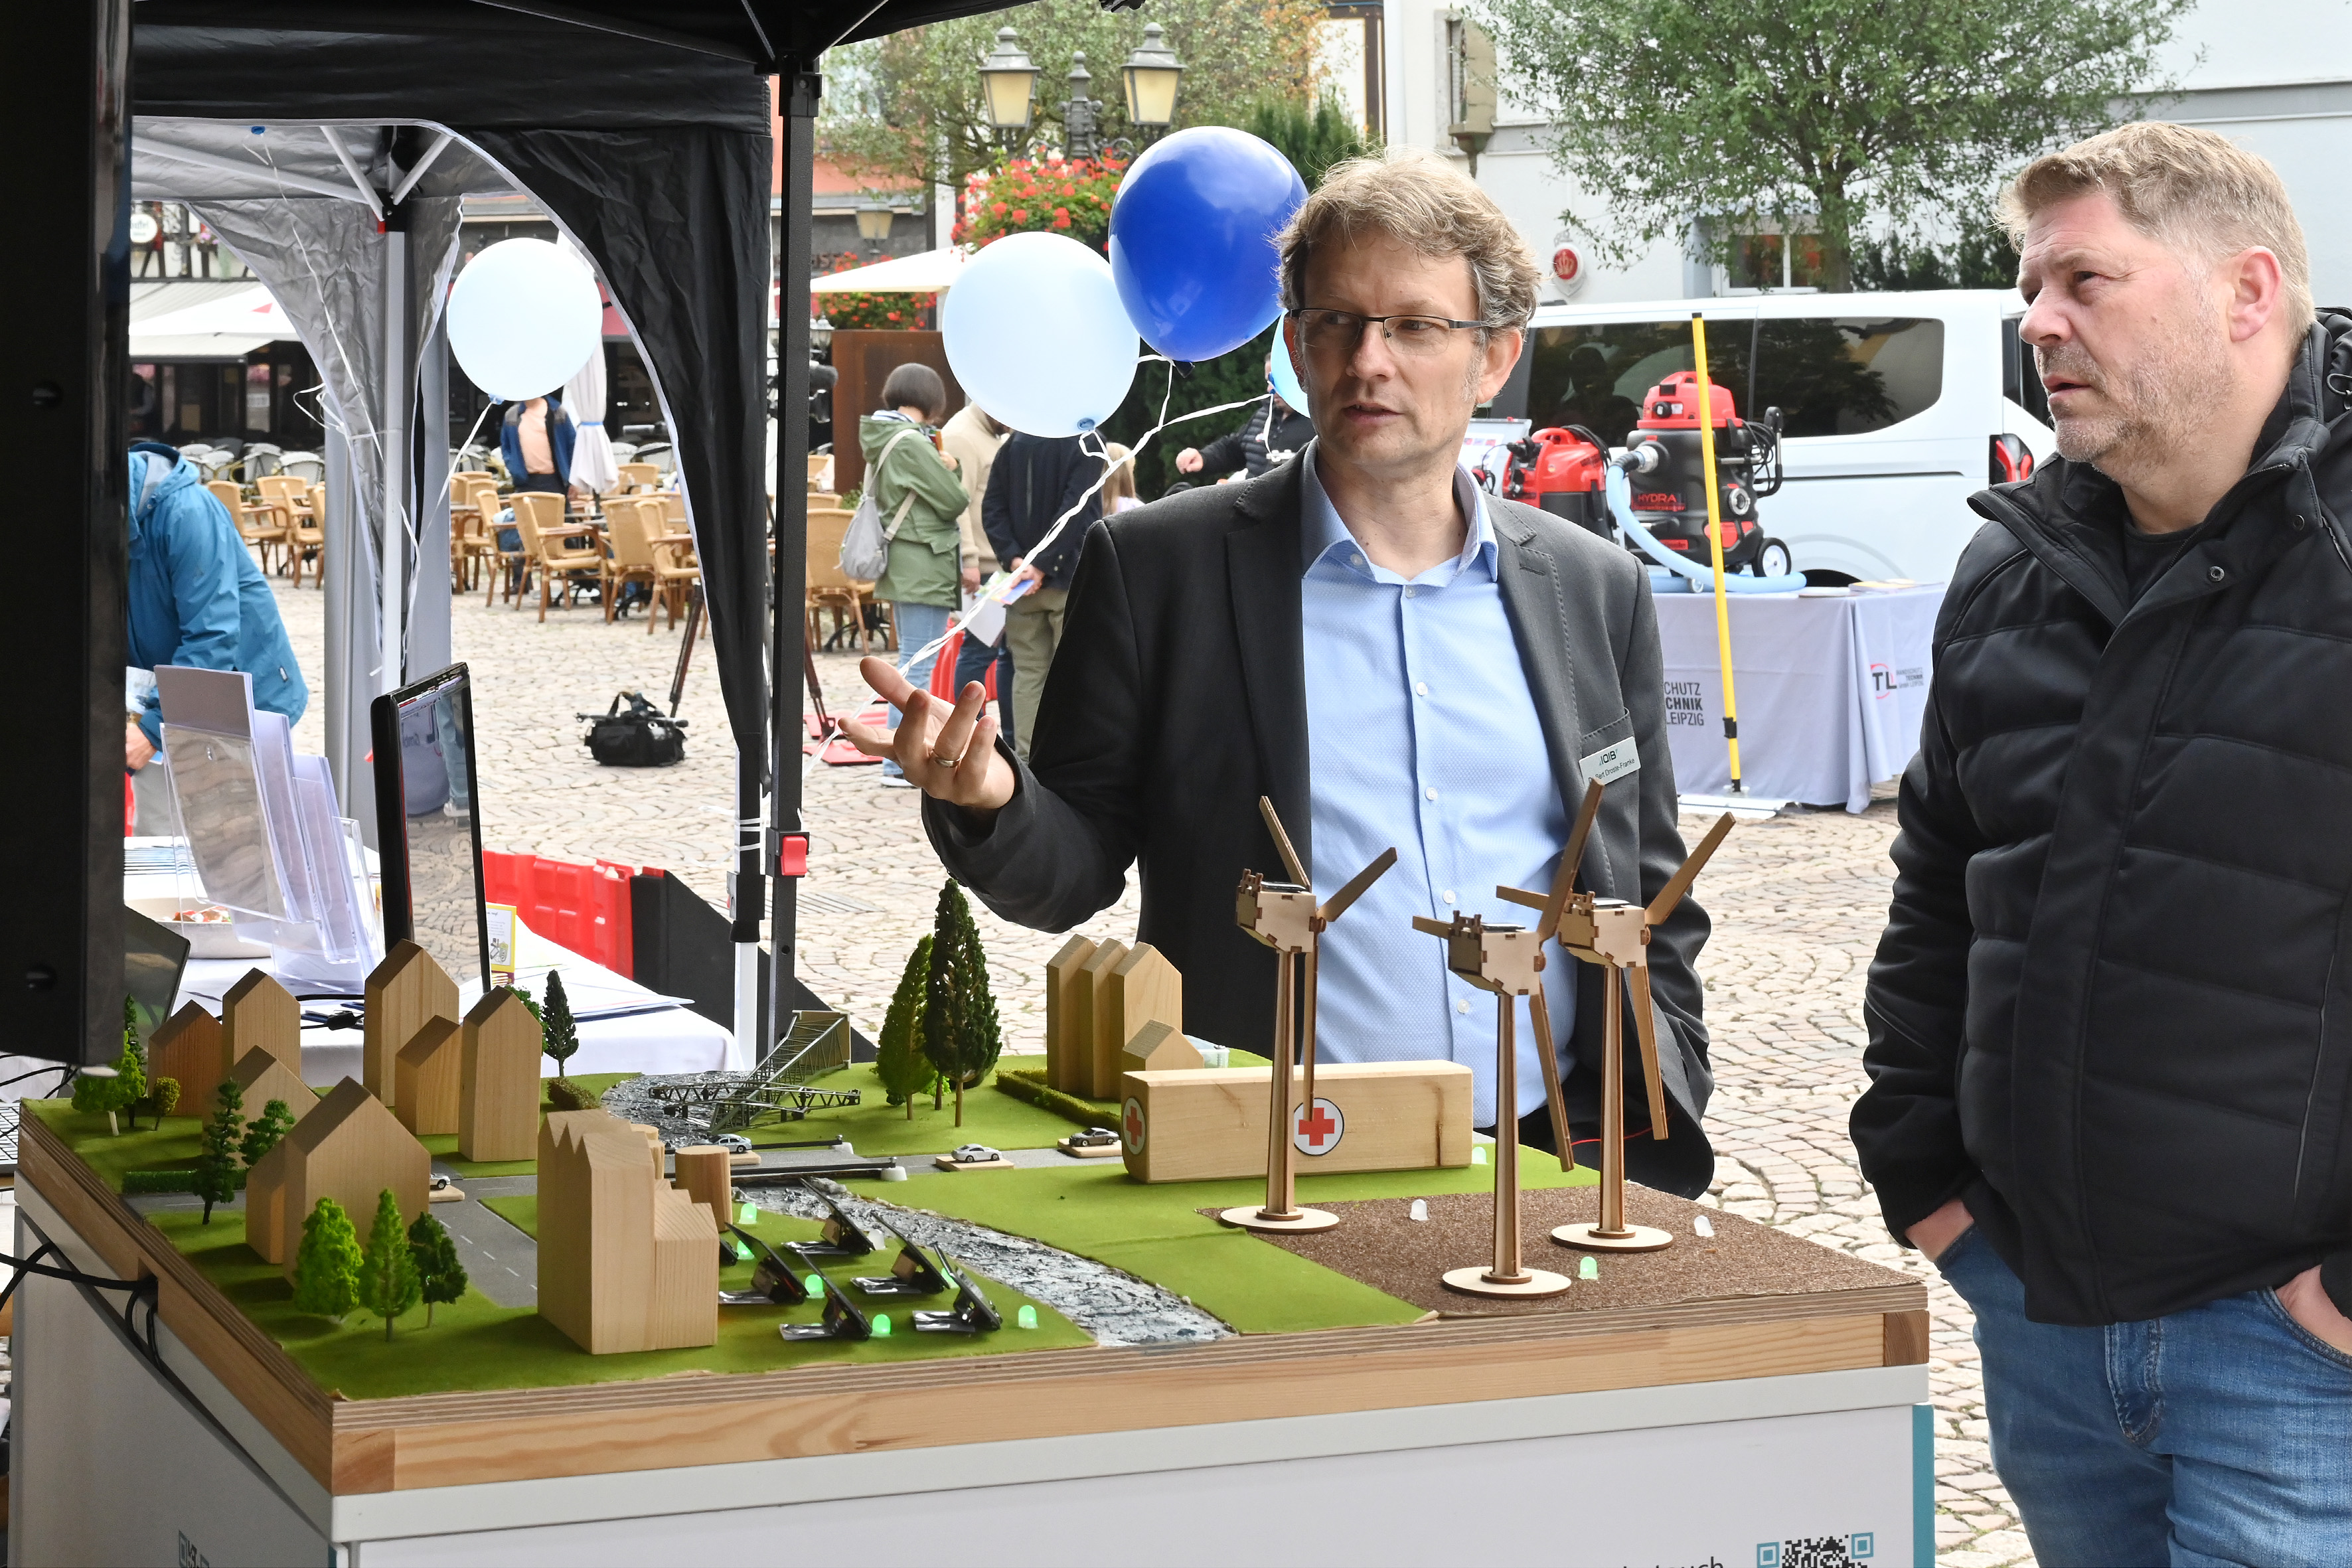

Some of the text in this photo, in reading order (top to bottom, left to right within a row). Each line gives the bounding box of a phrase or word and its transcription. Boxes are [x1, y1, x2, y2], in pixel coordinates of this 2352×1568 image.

[1638, 493, 1677, 503] HYDRA
[1664, 681, 1701, 696] CHUTZ
[1665, 696, 1703, 711] CHNIK
[1600, 750, 1617, 765] IQIB
